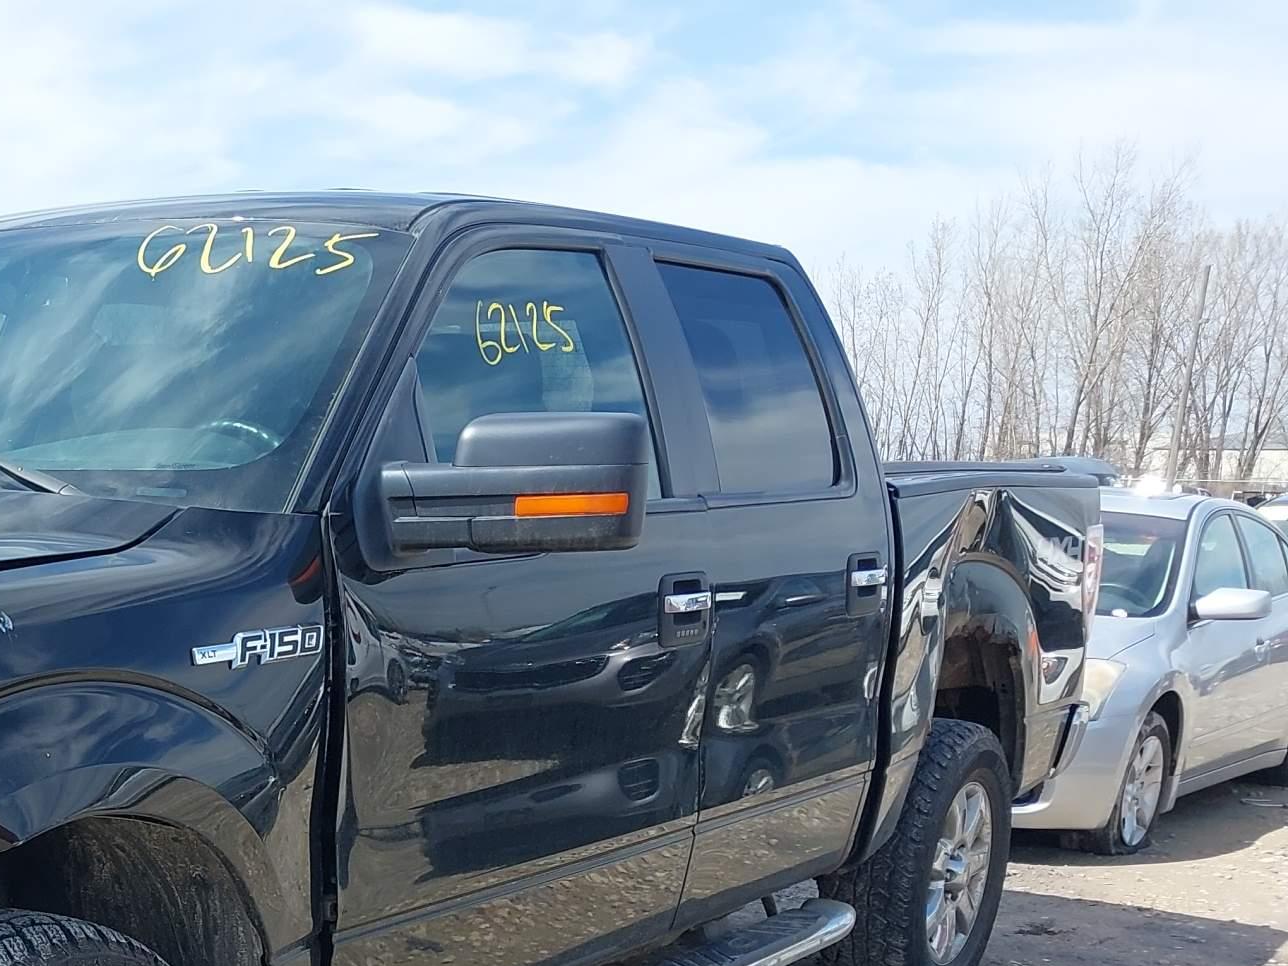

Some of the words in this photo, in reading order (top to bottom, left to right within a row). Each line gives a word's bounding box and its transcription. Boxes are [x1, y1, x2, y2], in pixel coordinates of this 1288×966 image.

[137, 223, 380, 281] 62125
[476, 300, 574, 365] 62125
[200, 649, 217, 659] XLT
[237, 626, 323, 666] F-150
